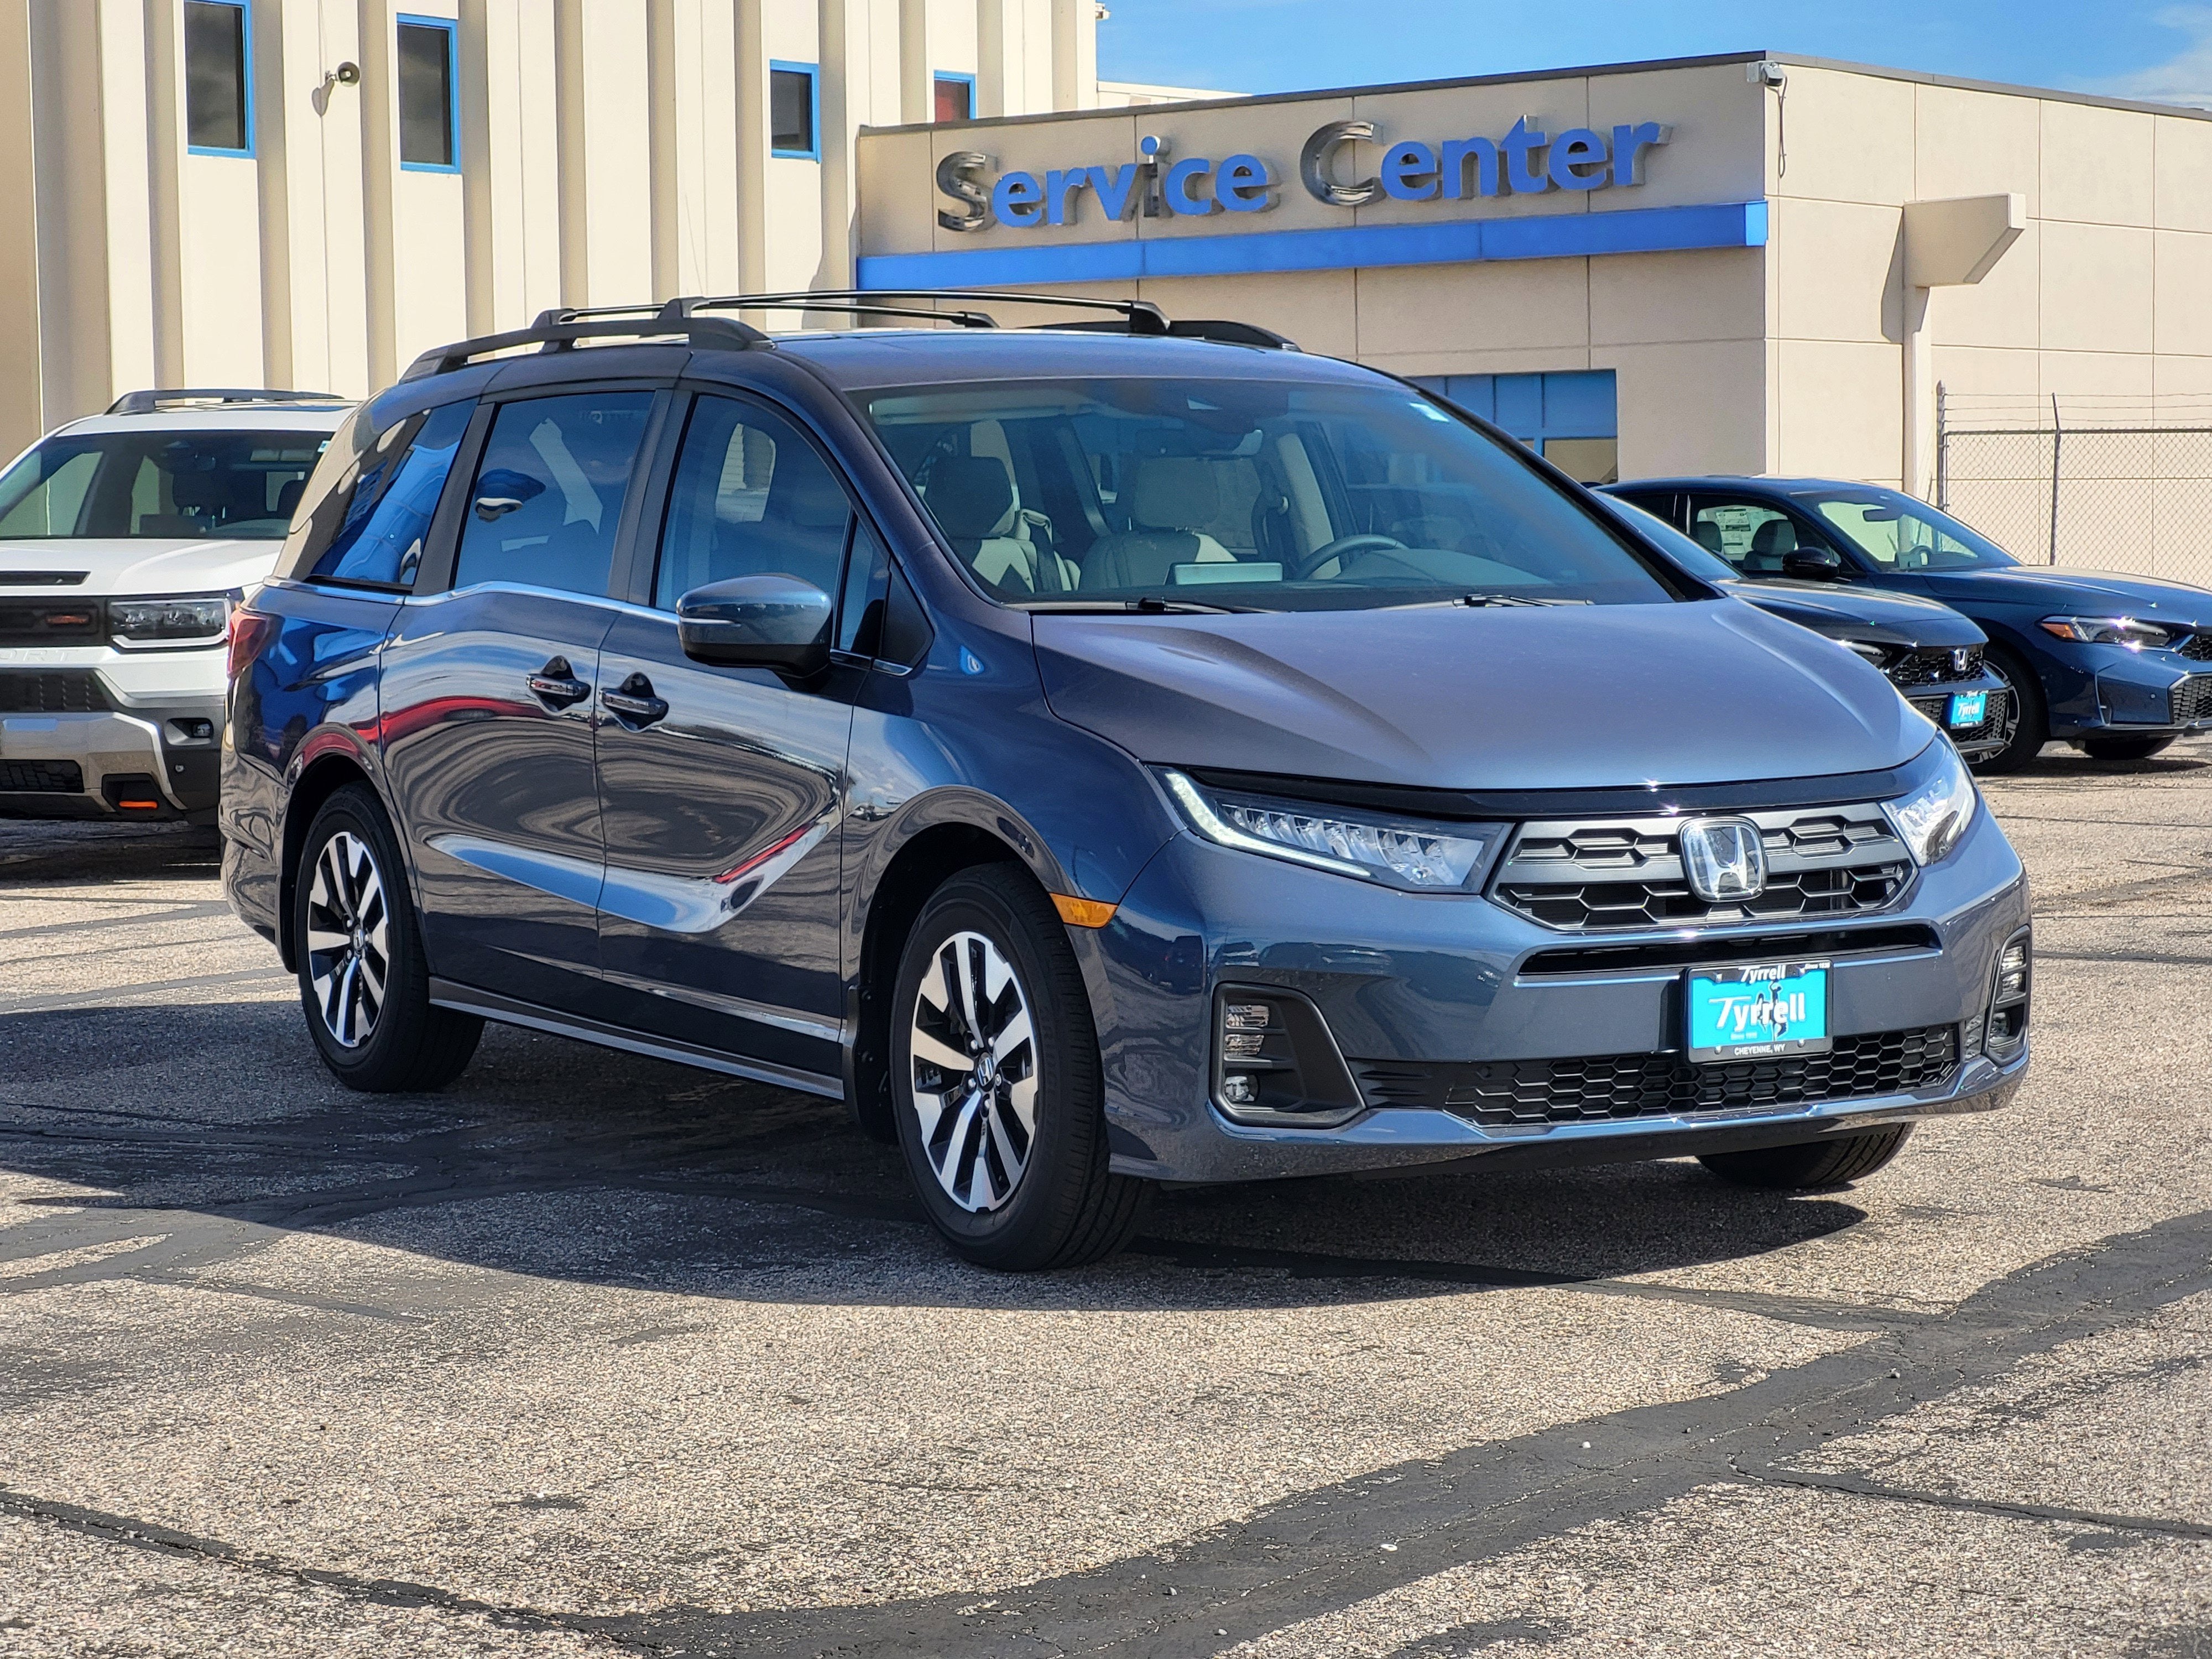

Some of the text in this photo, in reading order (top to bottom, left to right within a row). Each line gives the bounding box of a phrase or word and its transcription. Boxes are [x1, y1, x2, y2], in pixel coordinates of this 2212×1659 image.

[936, 113, 1669, 232] Service Center
[1738, 964, 1786, 984] Tyrrell
[1709, 992, 1806, 1032] Tyrrell
[1773, 1043, 1786, 1053] WY
